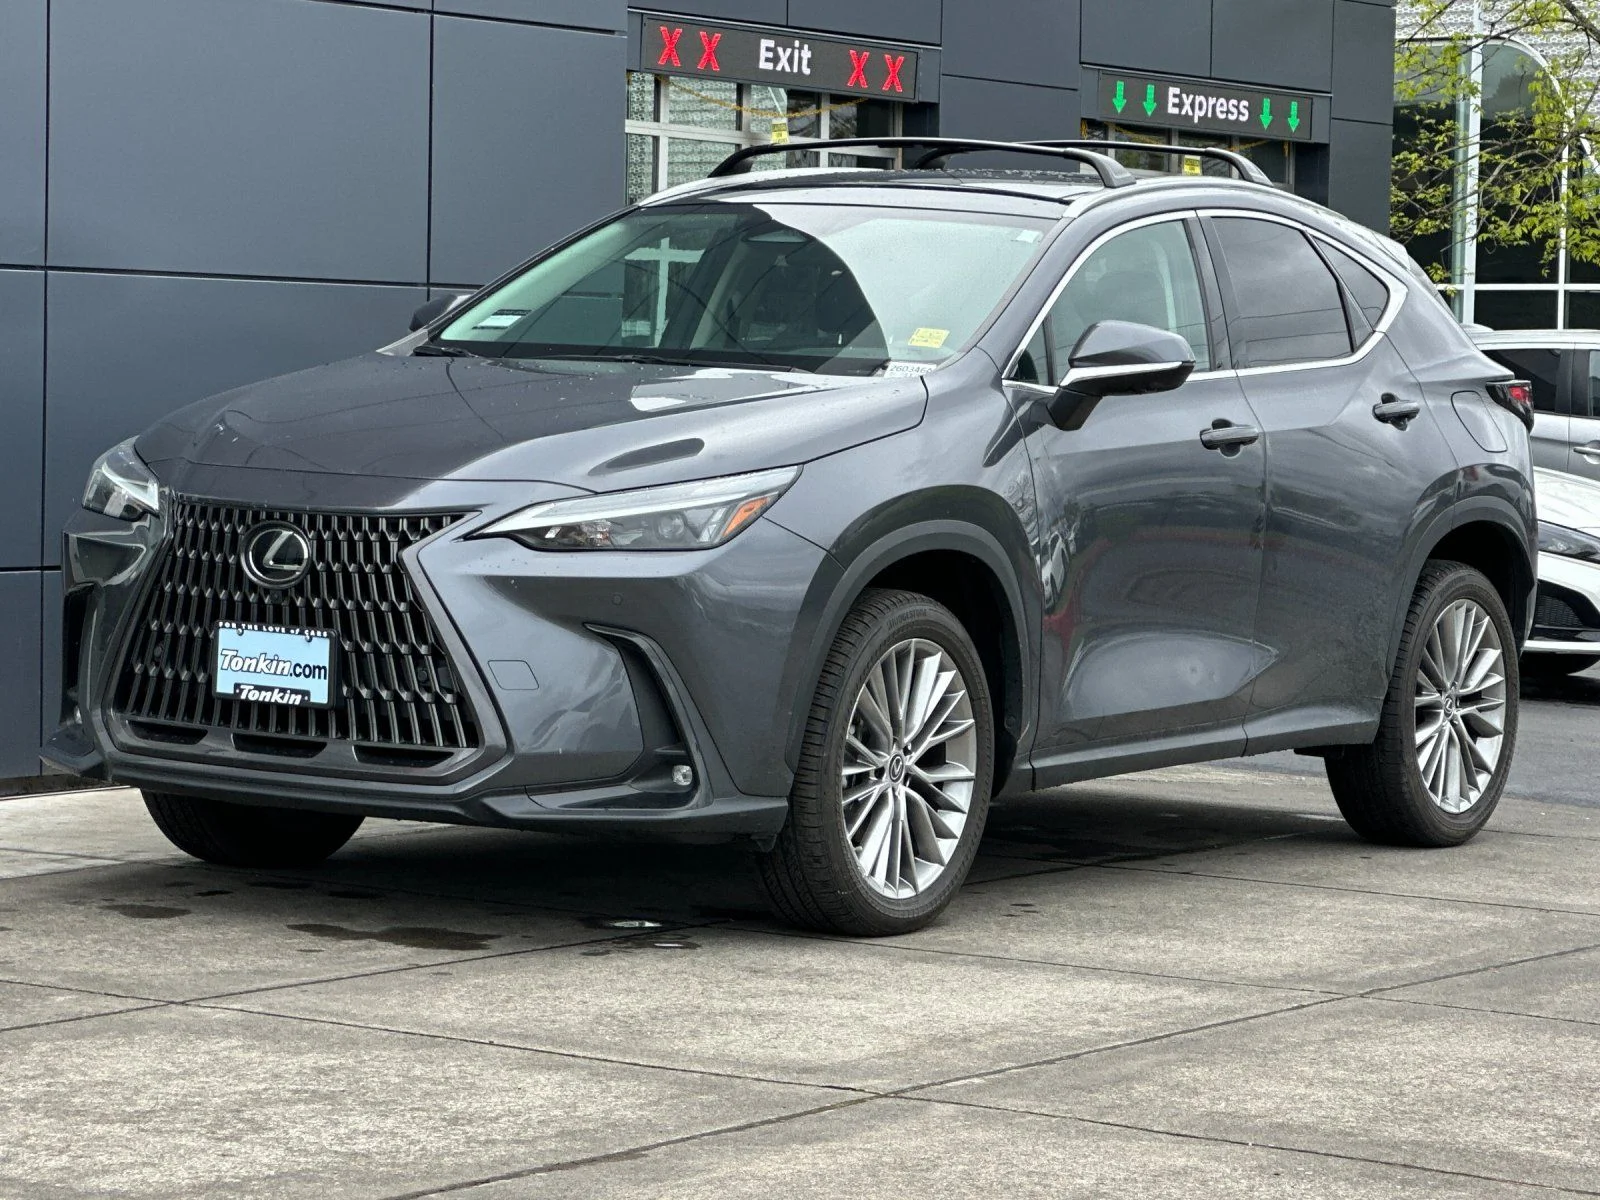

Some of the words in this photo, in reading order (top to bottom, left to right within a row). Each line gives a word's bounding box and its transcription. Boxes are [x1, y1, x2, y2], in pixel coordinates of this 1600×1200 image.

[759, 38, 812, 76] Exit
[1167, 86, 1249, 124] Express
[218, 621, 237, 629] FOR
[241, 623, 259, 631] THE
[262, 625, 286, 634] LOVE
[304, 629, 328, 638] CARS
[220, 648, 328, 681] Tonkin.com
[239, 684, 303, 706] Tonkin
